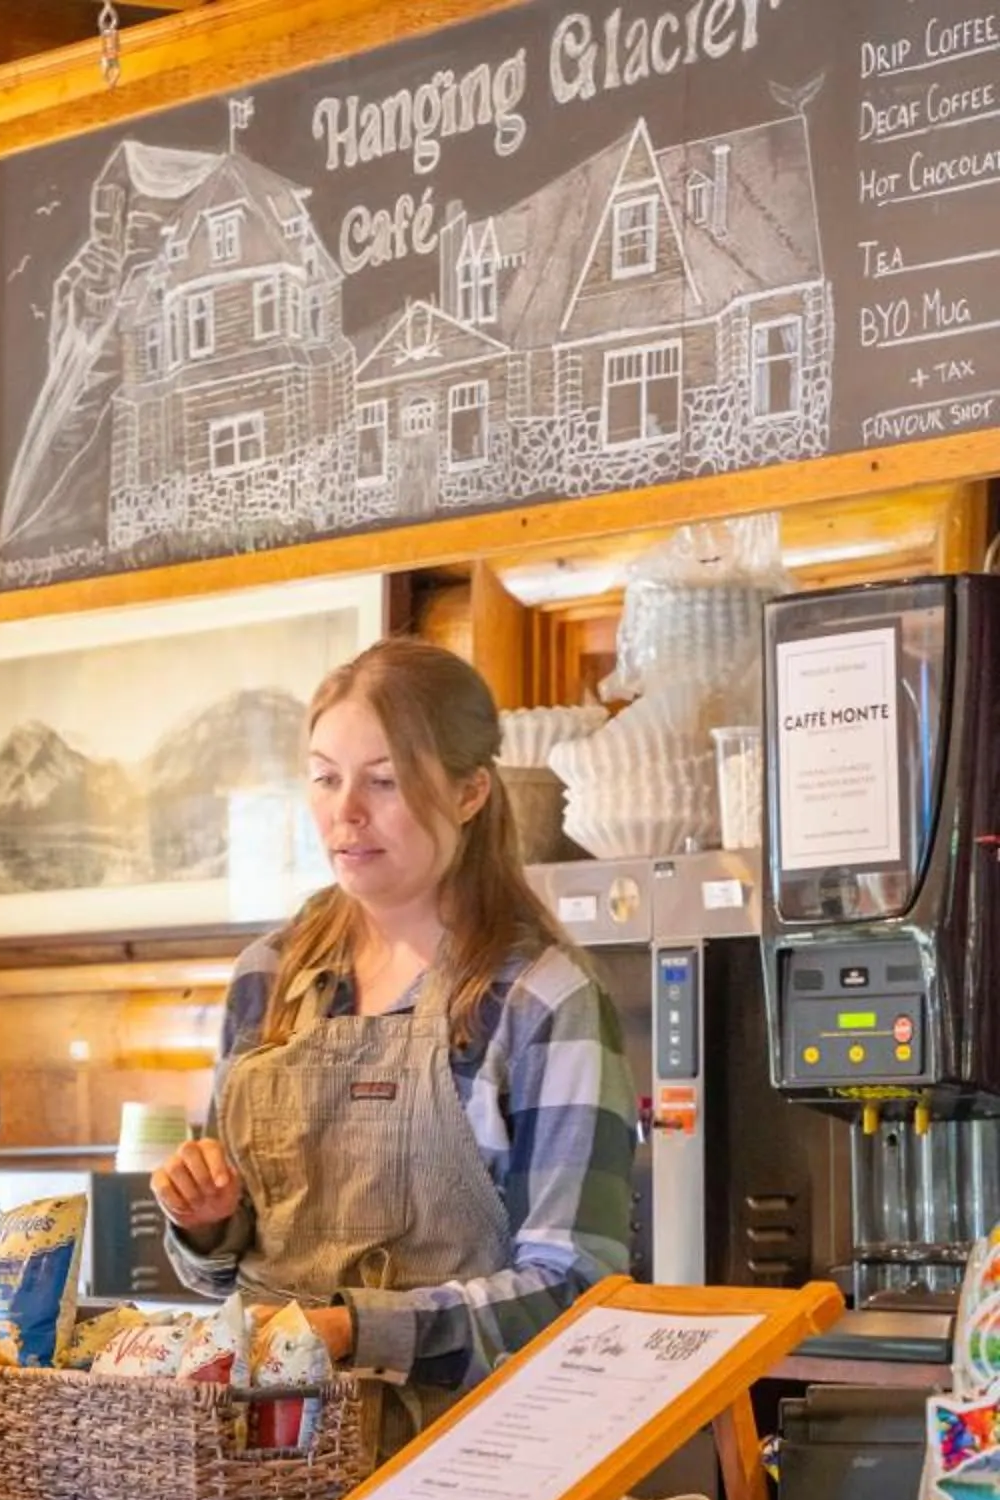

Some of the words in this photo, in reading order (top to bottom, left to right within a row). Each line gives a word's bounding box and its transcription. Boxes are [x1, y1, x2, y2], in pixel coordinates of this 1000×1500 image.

[312, 48, 527, 174] Hanging
[550, 0, 779, 104] Glacier
[338, 186, 440, 275] Café
[933, 359, 976, 383] TAX
[951, 399, 995, 425] SHOT
[831, 703, 889, 725] MONTE
